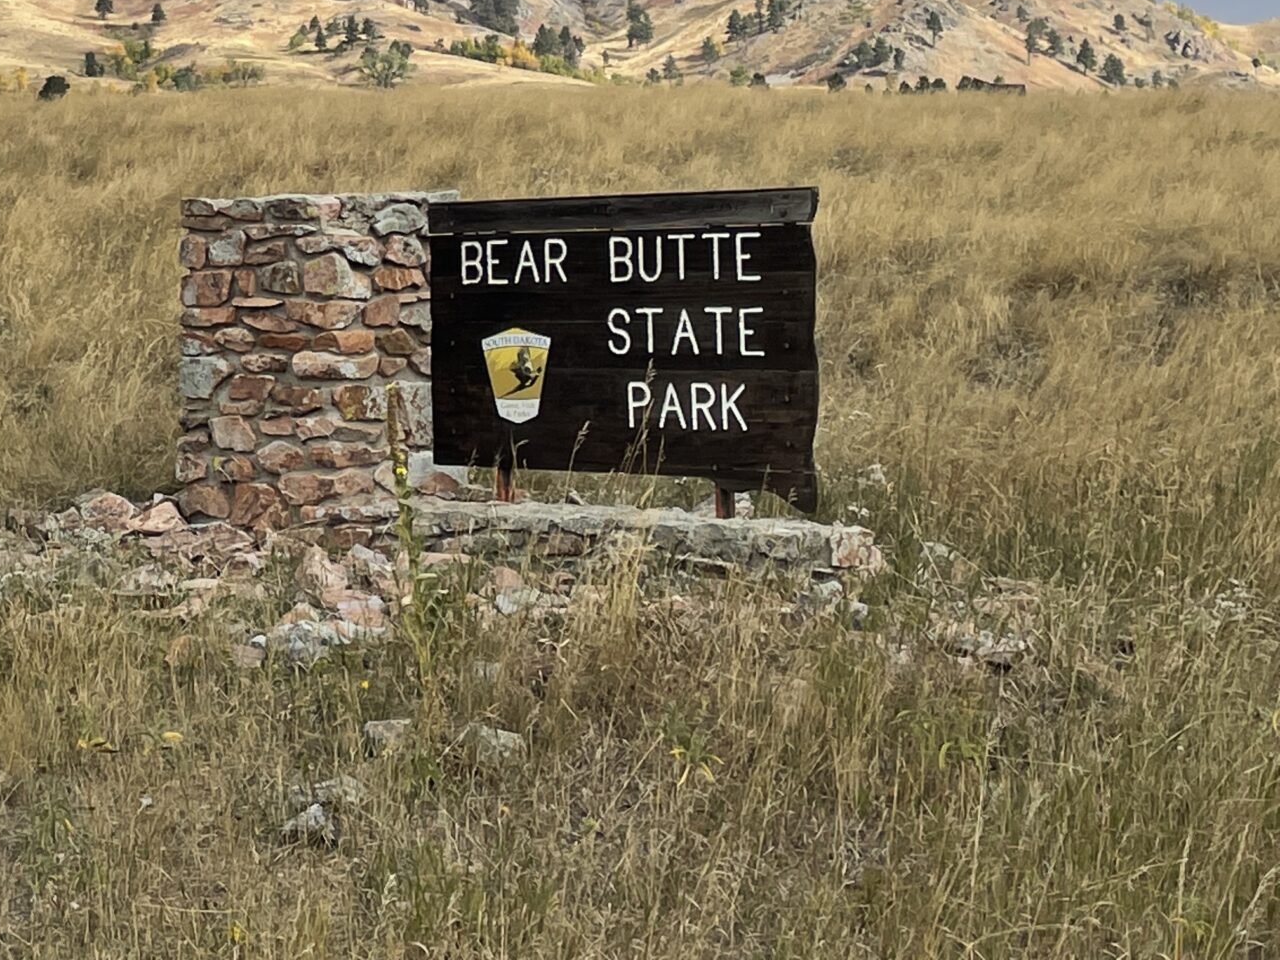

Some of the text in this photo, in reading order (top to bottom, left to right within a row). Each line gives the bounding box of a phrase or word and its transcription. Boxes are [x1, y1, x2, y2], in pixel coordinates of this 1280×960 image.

[461, 232, 762, 285] BEAR BUTTE
[608, 306, 765, 357] STATE
[627, 381, 749, 432] PARK
